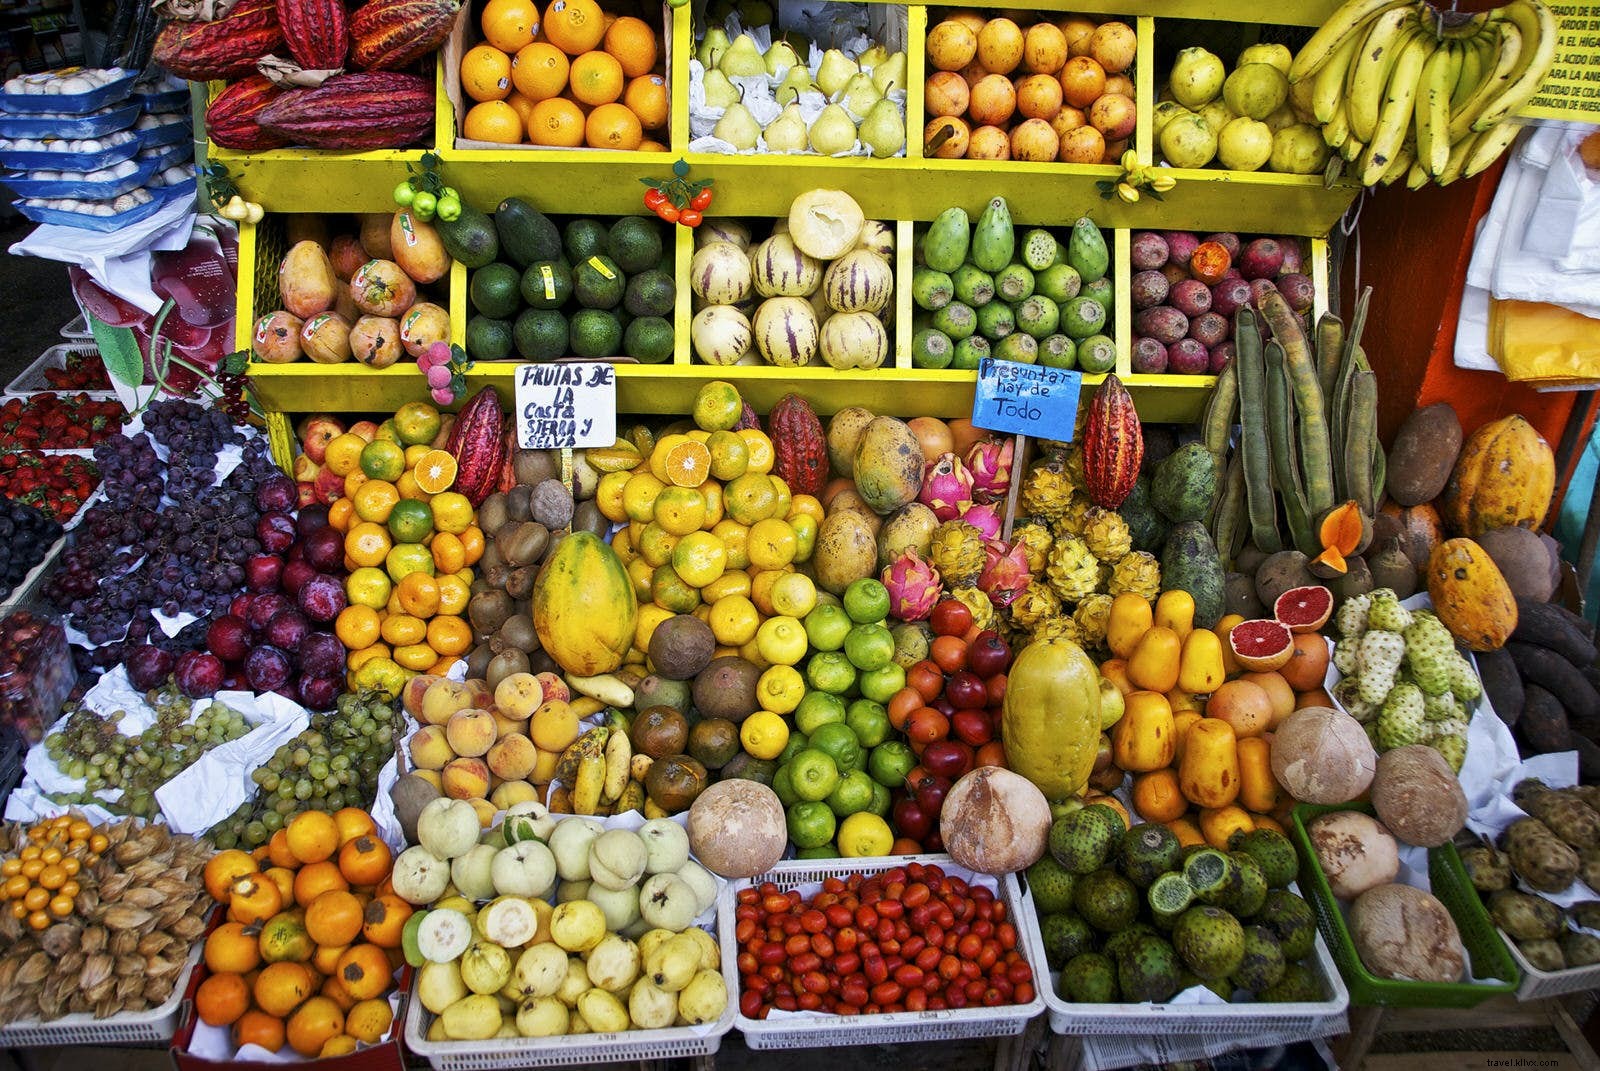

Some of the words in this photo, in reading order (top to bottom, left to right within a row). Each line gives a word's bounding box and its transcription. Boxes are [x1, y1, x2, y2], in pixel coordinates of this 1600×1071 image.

[1578, 6, 1590, 17] DE
[1559, 19, 1588, 31] ARDOR
[1566, 36, 1576, 47] EL
[1562, 53, 1588, 65] ACIDO
[1569, 70, 1581, 80] LA
[1537, 84, 1570, 96] ANTIDAD
[1571, 86, 1582, 97] DE
[1568, 99, 1579, 110] DE
[522, 364, 583, 386] FRUTAS
[585, 365, 614, 388] DE
[981, 358, 1072, 384] Preguntar
[996, 376, 1023, 397] hay
[1030, 382, 1051, 398] de
[553, 386, 574, 405] LA
[992, 397, 1042, 421] Todo
